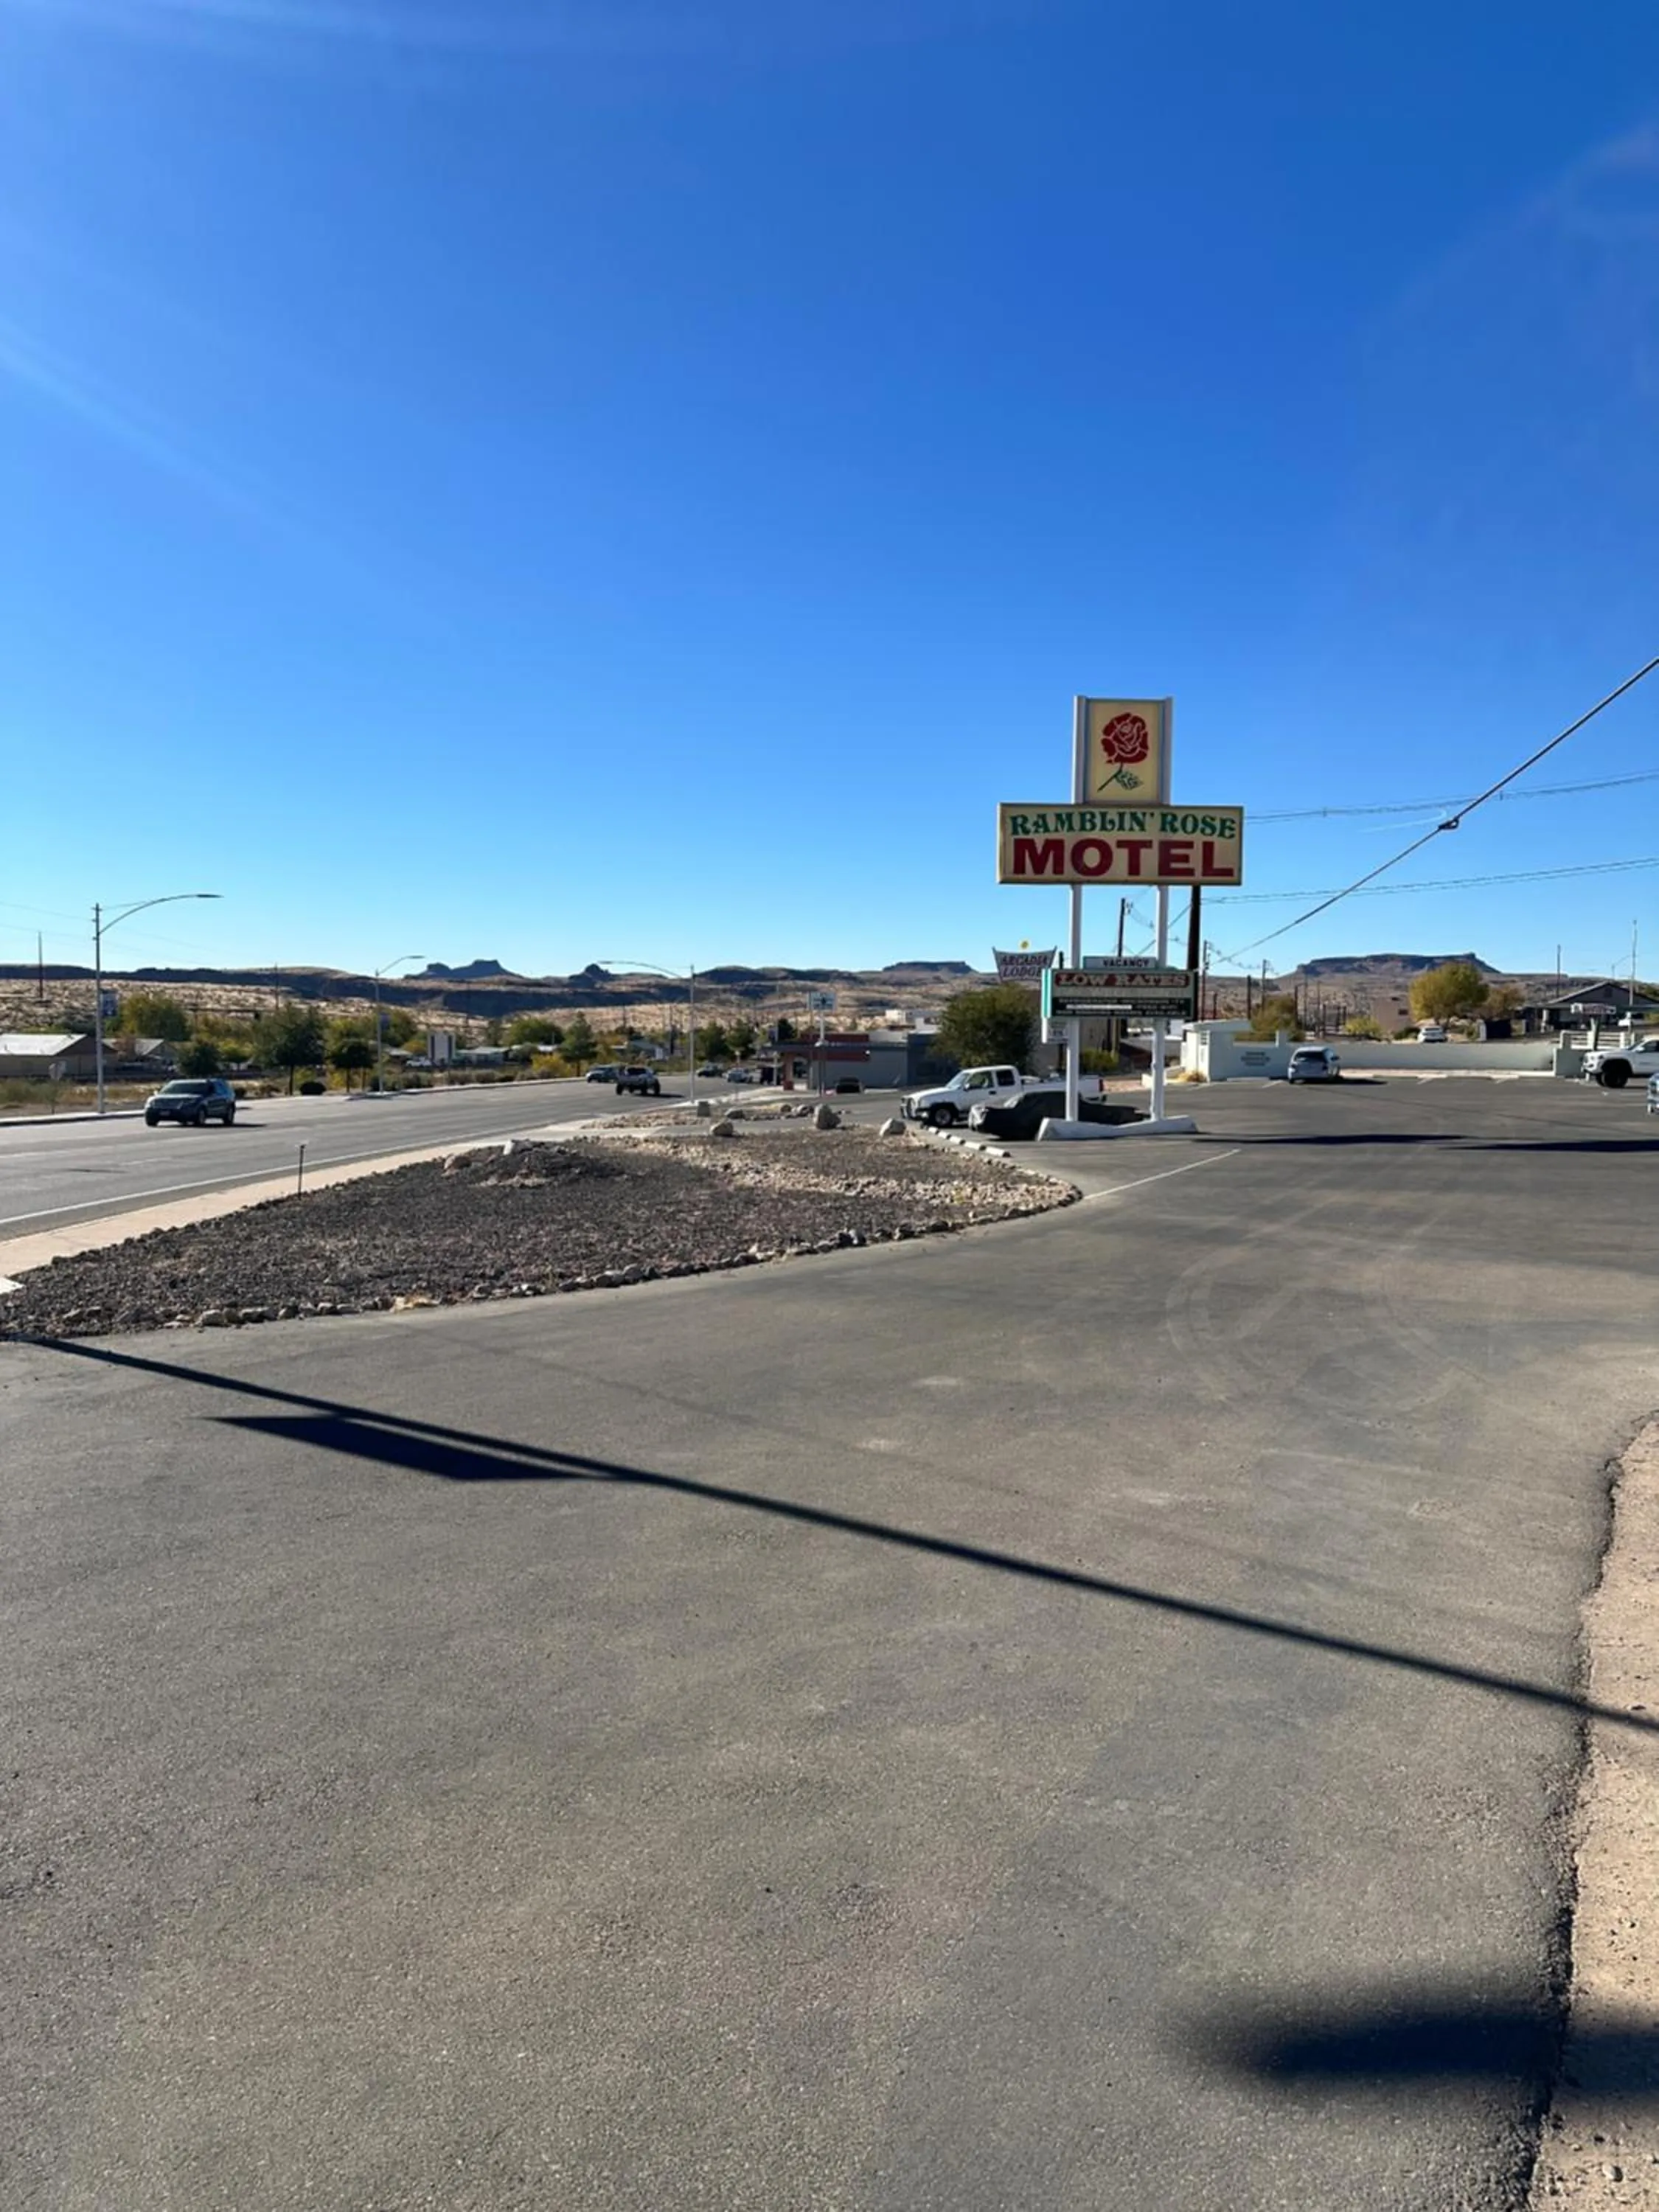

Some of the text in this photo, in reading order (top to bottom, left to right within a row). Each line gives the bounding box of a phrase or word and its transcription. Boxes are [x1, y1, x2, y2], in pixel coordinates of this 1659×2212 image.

[1010, 810, 1236, 839] RAMBLIN' ROSE
[1013, 838, 1234, 876] MOTEL
[1103, 959, 1149, 967] VACANCY
[1060, 974, 1186, 987] LOW RATES
